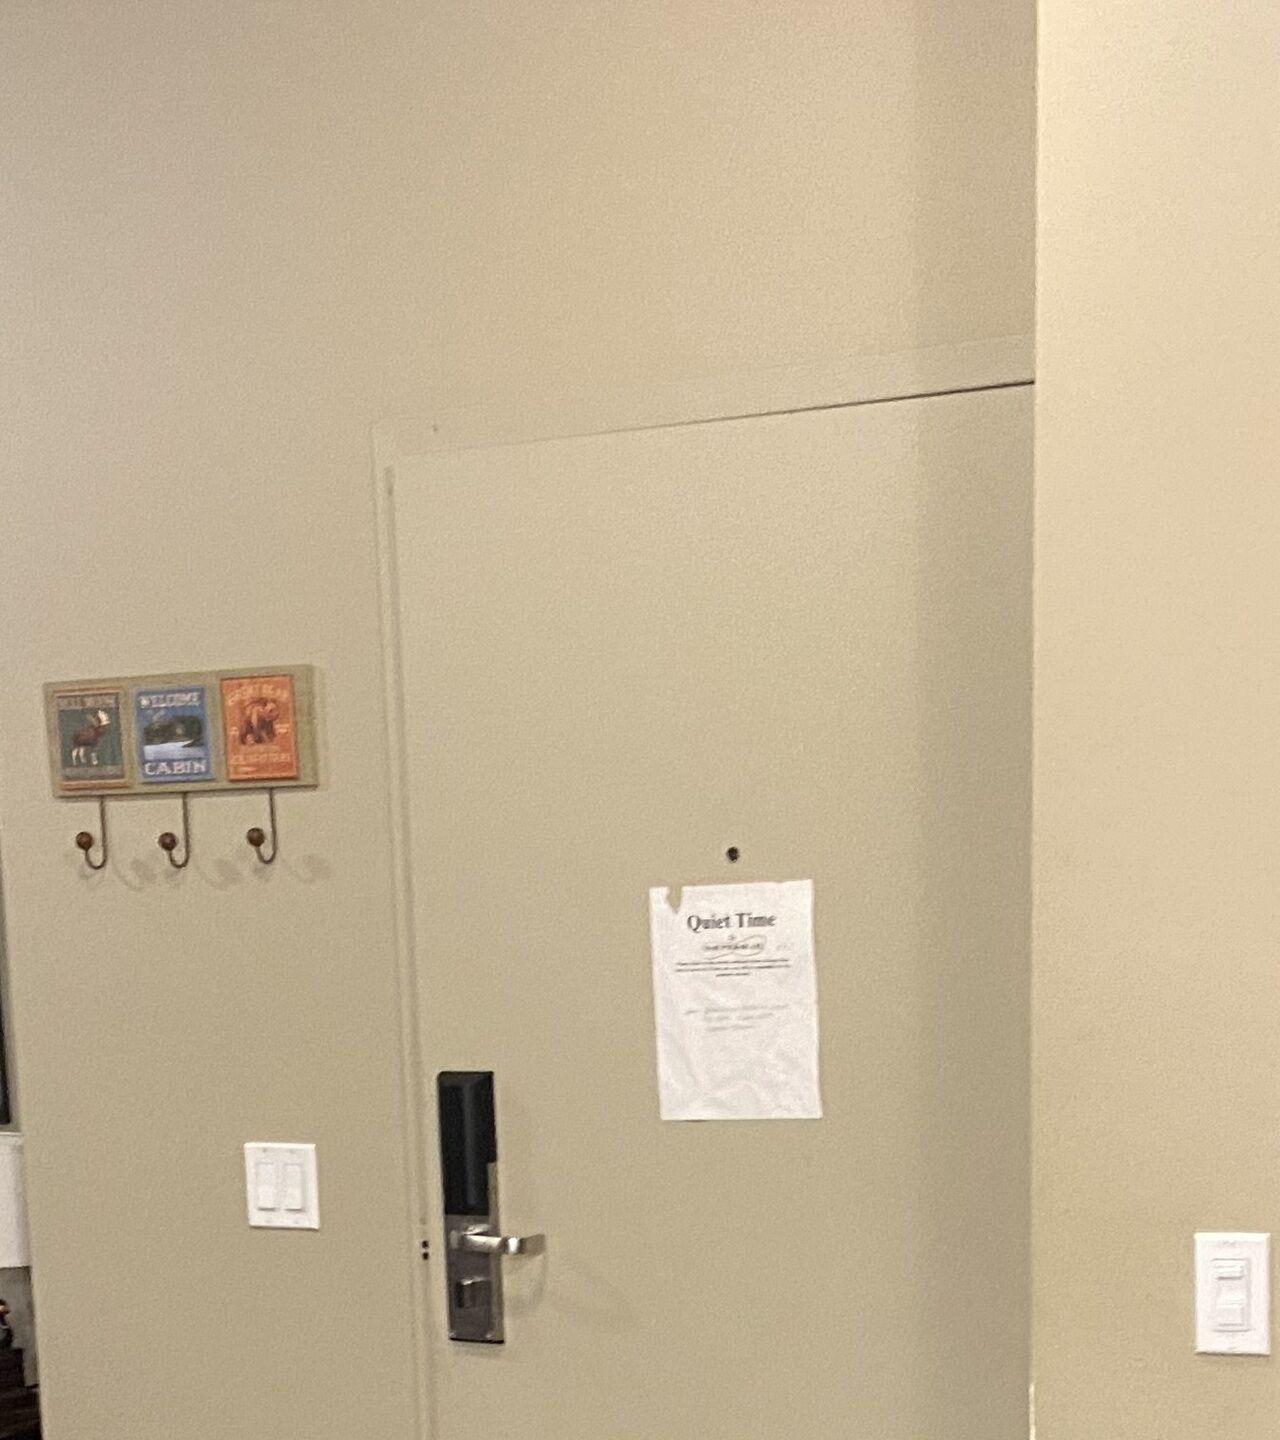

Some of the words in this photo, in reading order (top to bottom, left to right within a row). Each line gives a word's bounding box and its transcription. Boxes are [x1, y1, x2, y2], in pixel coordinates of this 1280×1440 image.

[144, 760, 207, 775] CABIN
[686, 913, 730, 933] Quiet
[735, 912, 777, 928] Time
